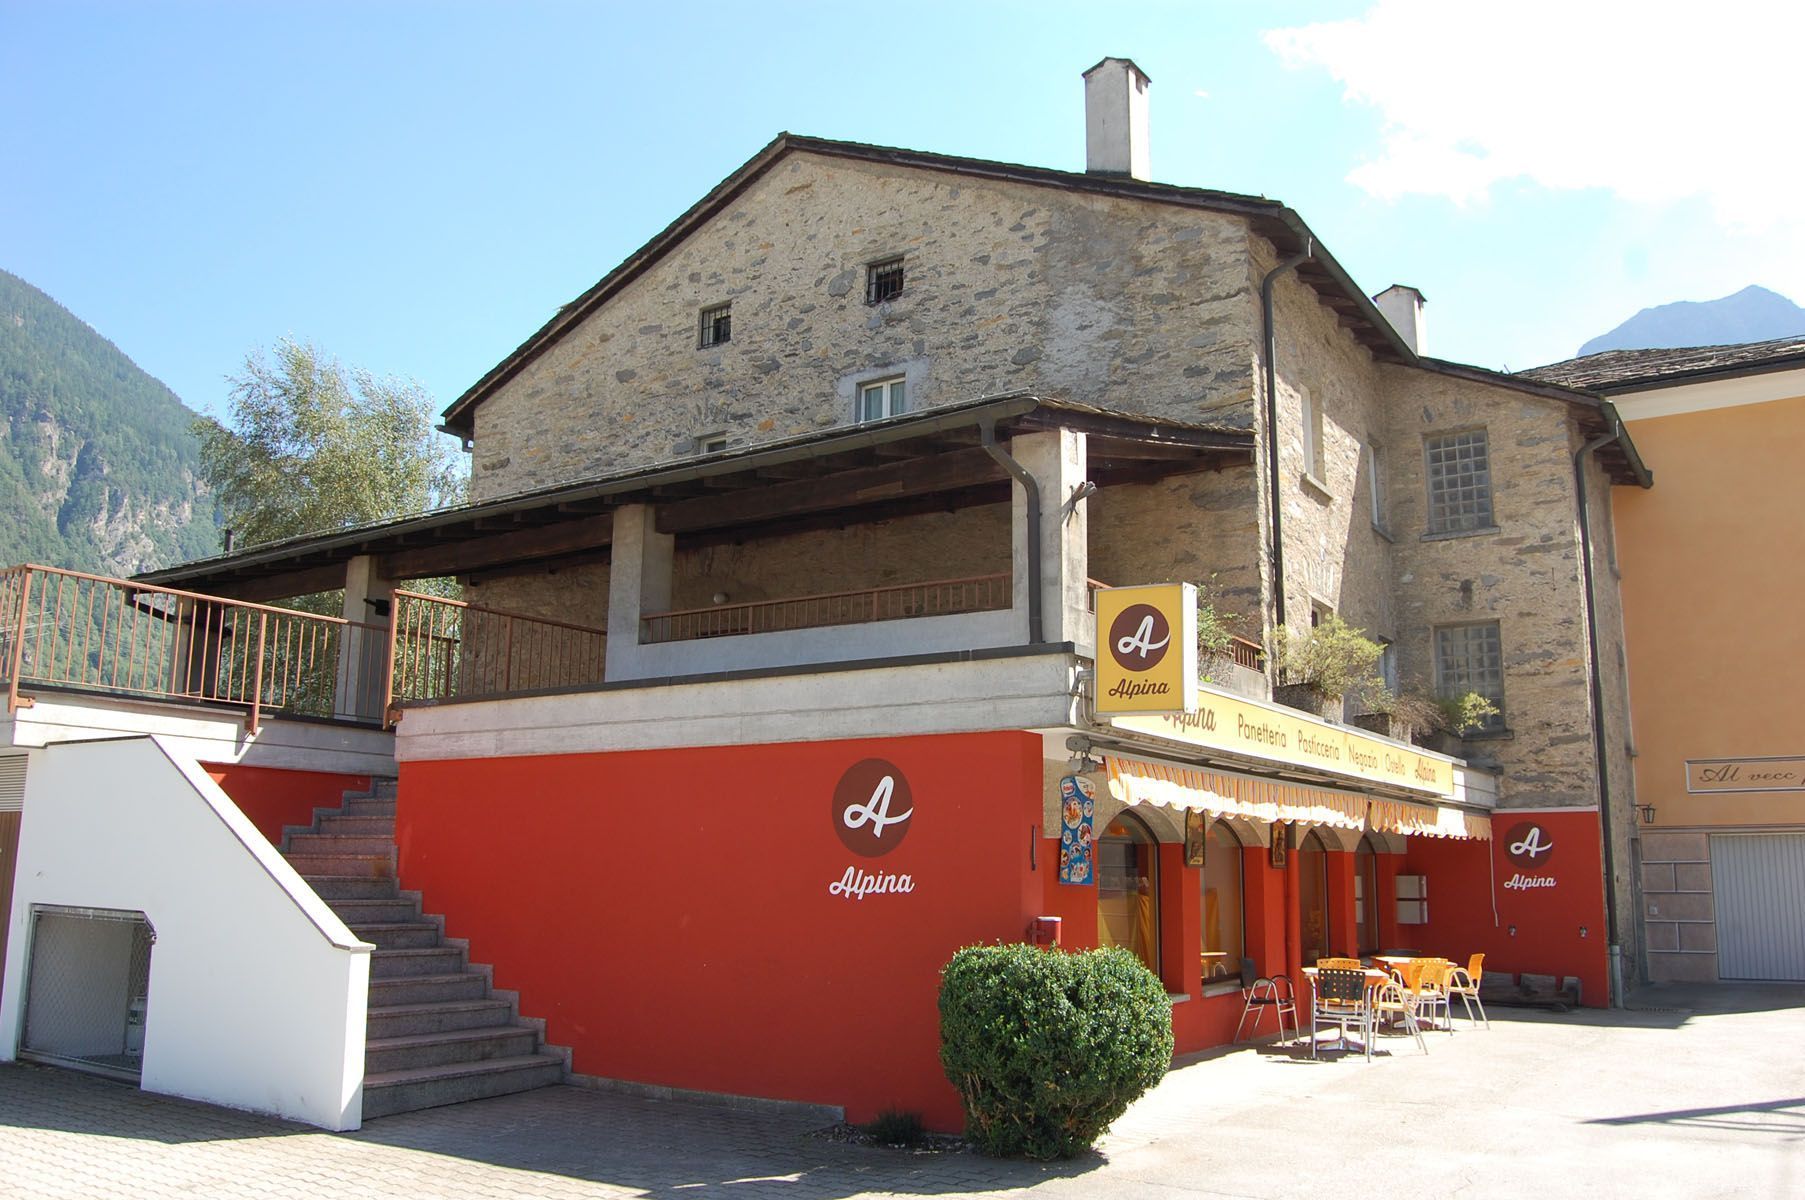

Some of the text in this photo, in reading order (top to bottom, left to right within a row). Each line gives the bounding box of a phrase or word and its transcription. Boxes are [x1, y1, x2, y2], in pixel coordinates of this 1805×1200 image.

[1117, 615, 1171, 659] A
[1108, 678, 1170, 700] Alpina
[1238, 713, 1287, 748] Panetteria
[1298, 729, 1340, 760] Pasticceria
[1348, 743, 1378, 772] Negozio
[1414, 757, 1437, 783] Alpina
[1698, 764, 1797, 783] Al vecc
[843, 775, 914, 838] A
[1510, 827, 1553, 858] A
[828, 865, 916, 900] Alpina
[1503, 873, 1557, 891] Alpina
